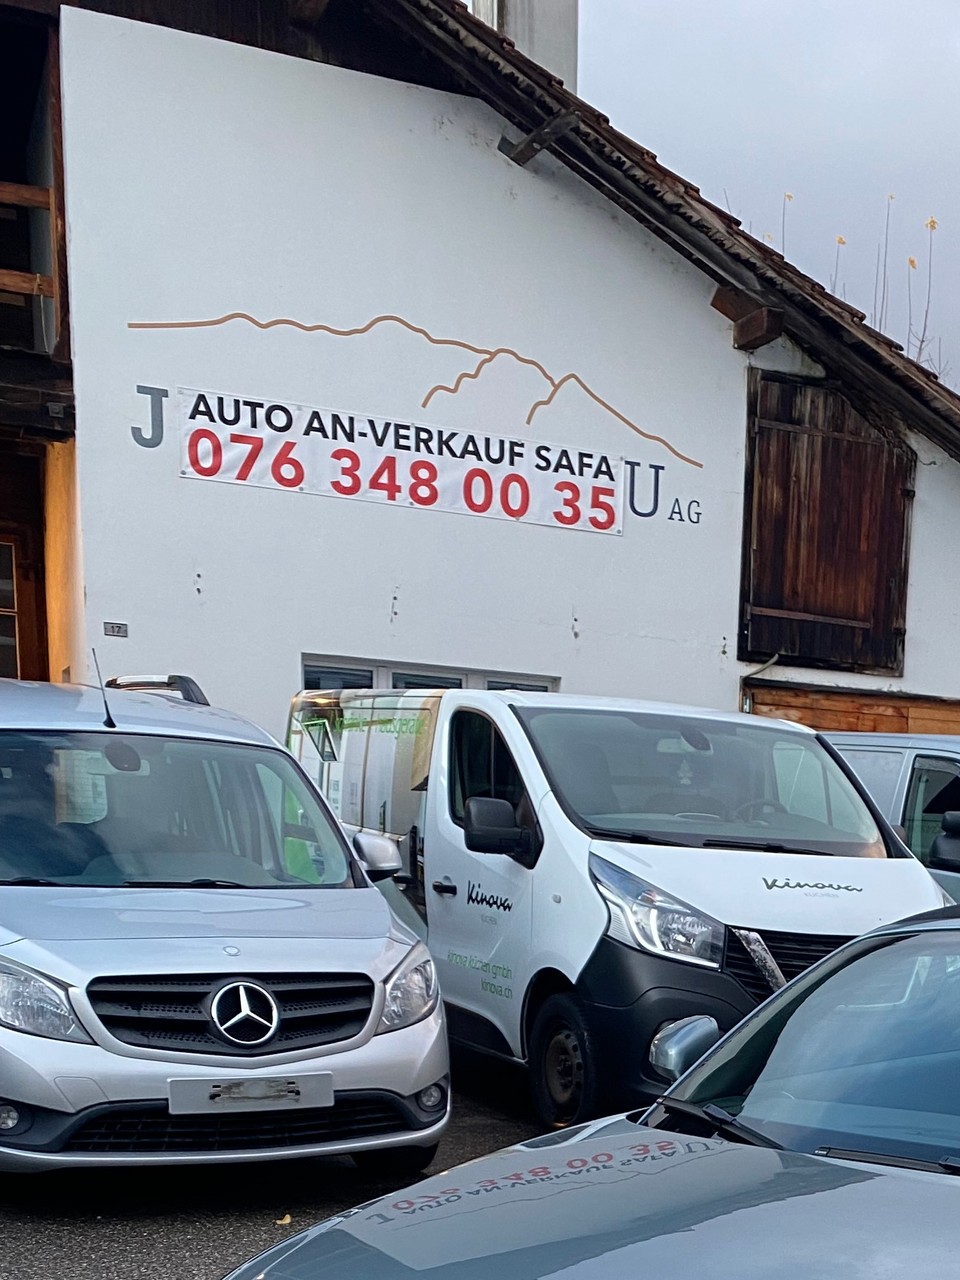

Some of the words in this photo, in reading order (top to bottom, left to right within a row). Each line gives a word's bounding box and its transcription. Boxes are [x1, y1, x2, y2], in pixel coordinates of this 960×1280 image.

[131, 384, 168, 449] J
[188, 393, 293, 433] AUTO
[302, 410, 525, 467] AN-VERKAUF
[534, 445, 616, 482] SAFA
[187, 428, 305, 488] 076
[330, 449, 439, 506] 348
[463, 467, 530, 518] 00
[553, 480, 616, 531] 35
[667, 497, 703, 525] AG
[467, 880, 512, 912] Kinova
[762, 877, 863, 893] Kinova
